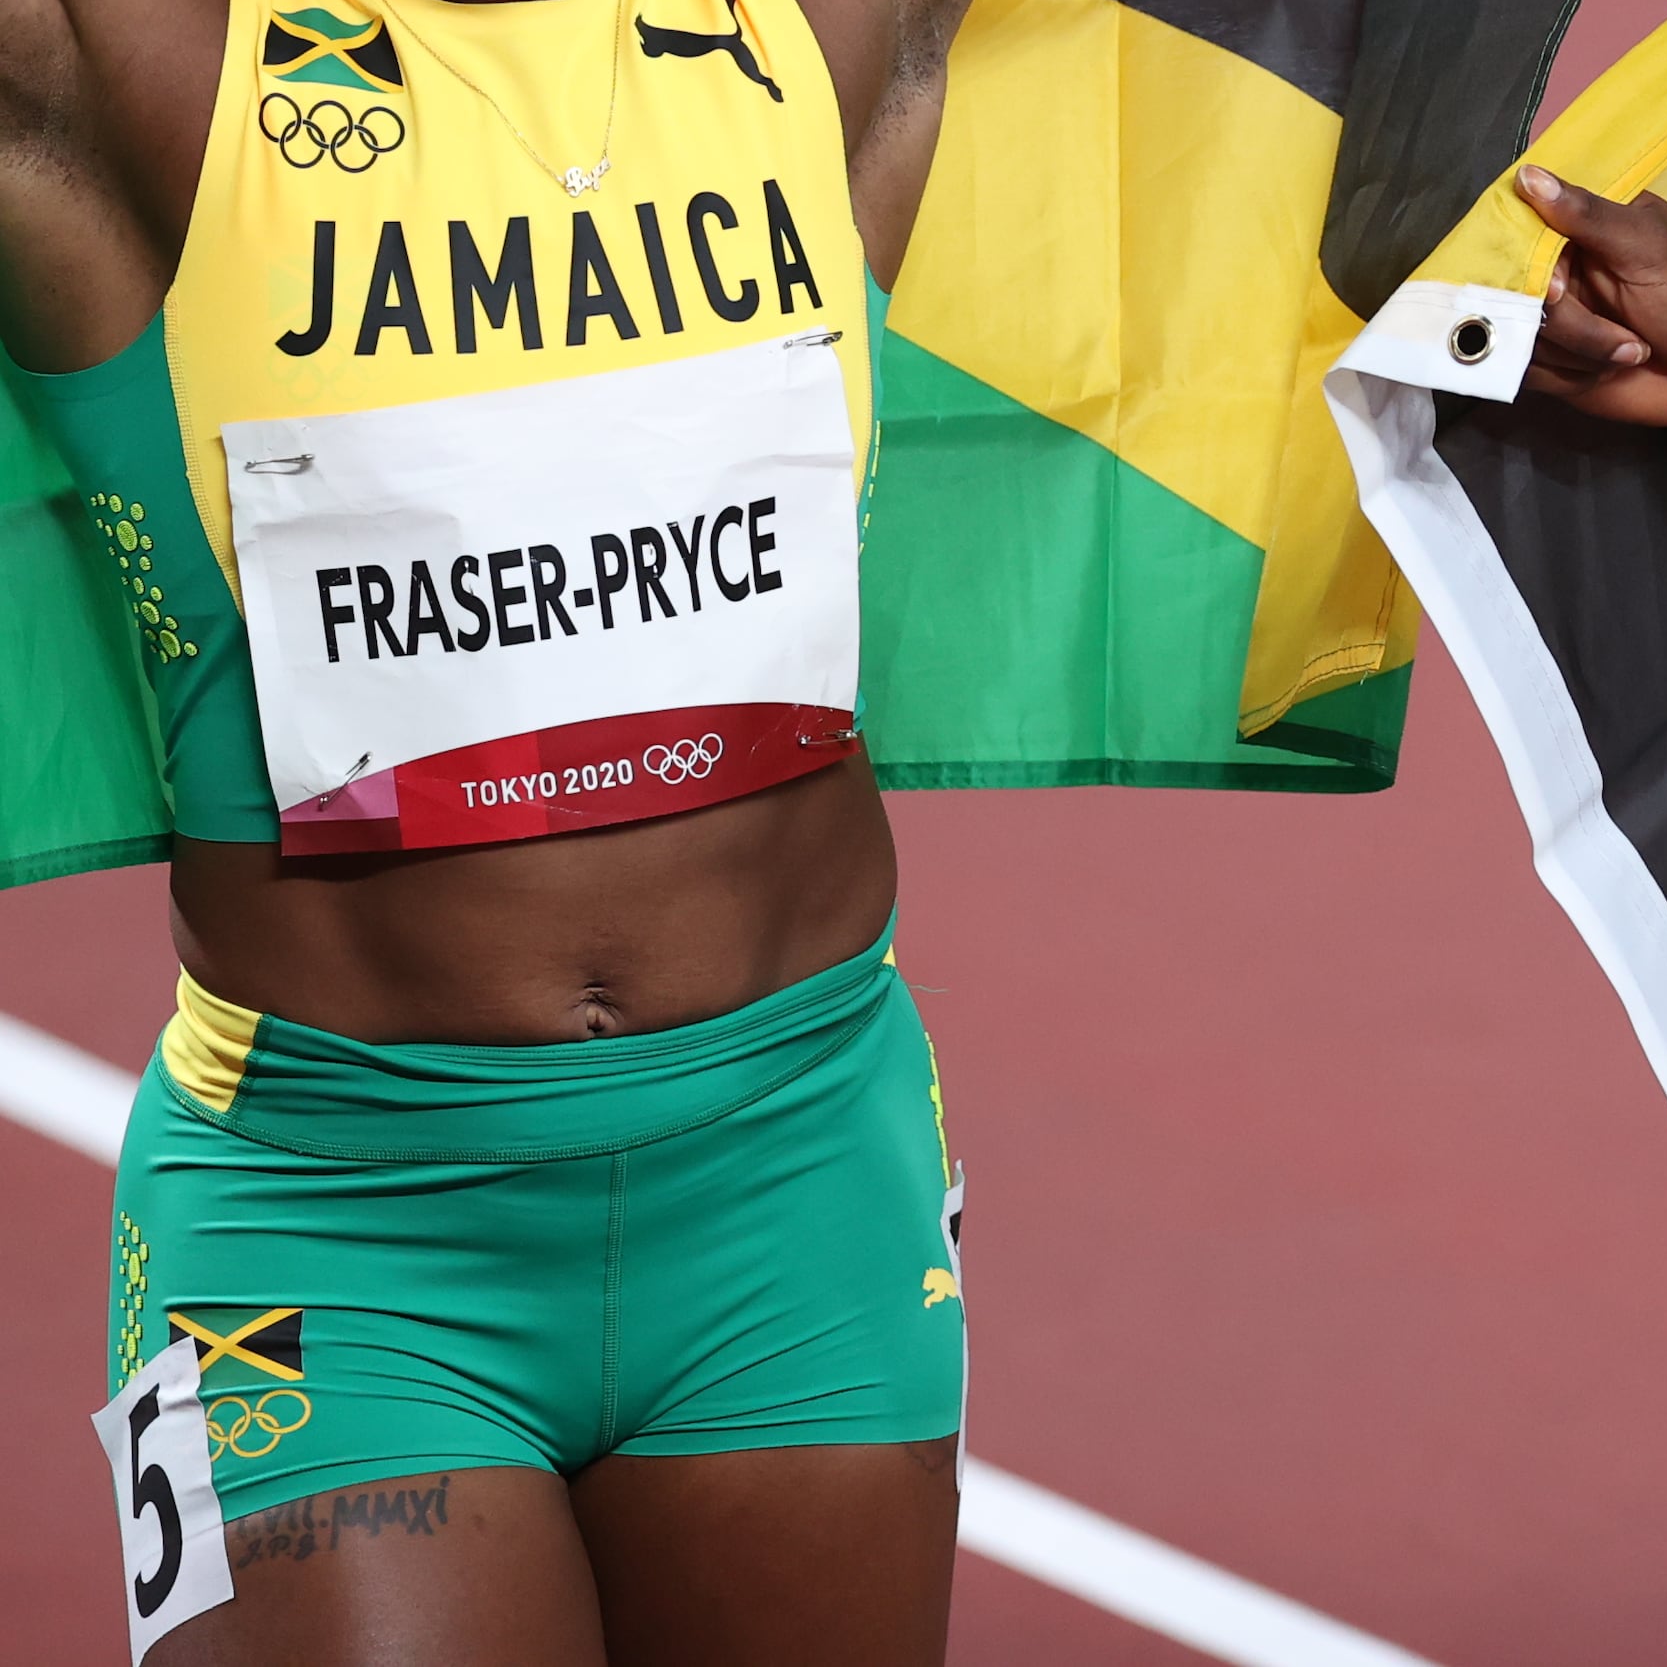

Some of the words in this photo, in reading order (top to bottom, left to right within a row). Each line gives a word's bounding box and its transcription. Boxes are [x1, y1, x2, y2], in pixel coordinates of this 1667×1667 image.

[274, 178, 823, 357] JAMAICA
[315, 495, 783, 663] FRASER-PRYCE
[461, 770, 559, 809] TOKYO
[563, 757, 635, 796] 2020
[128, 1382, 184, 1619] 5
